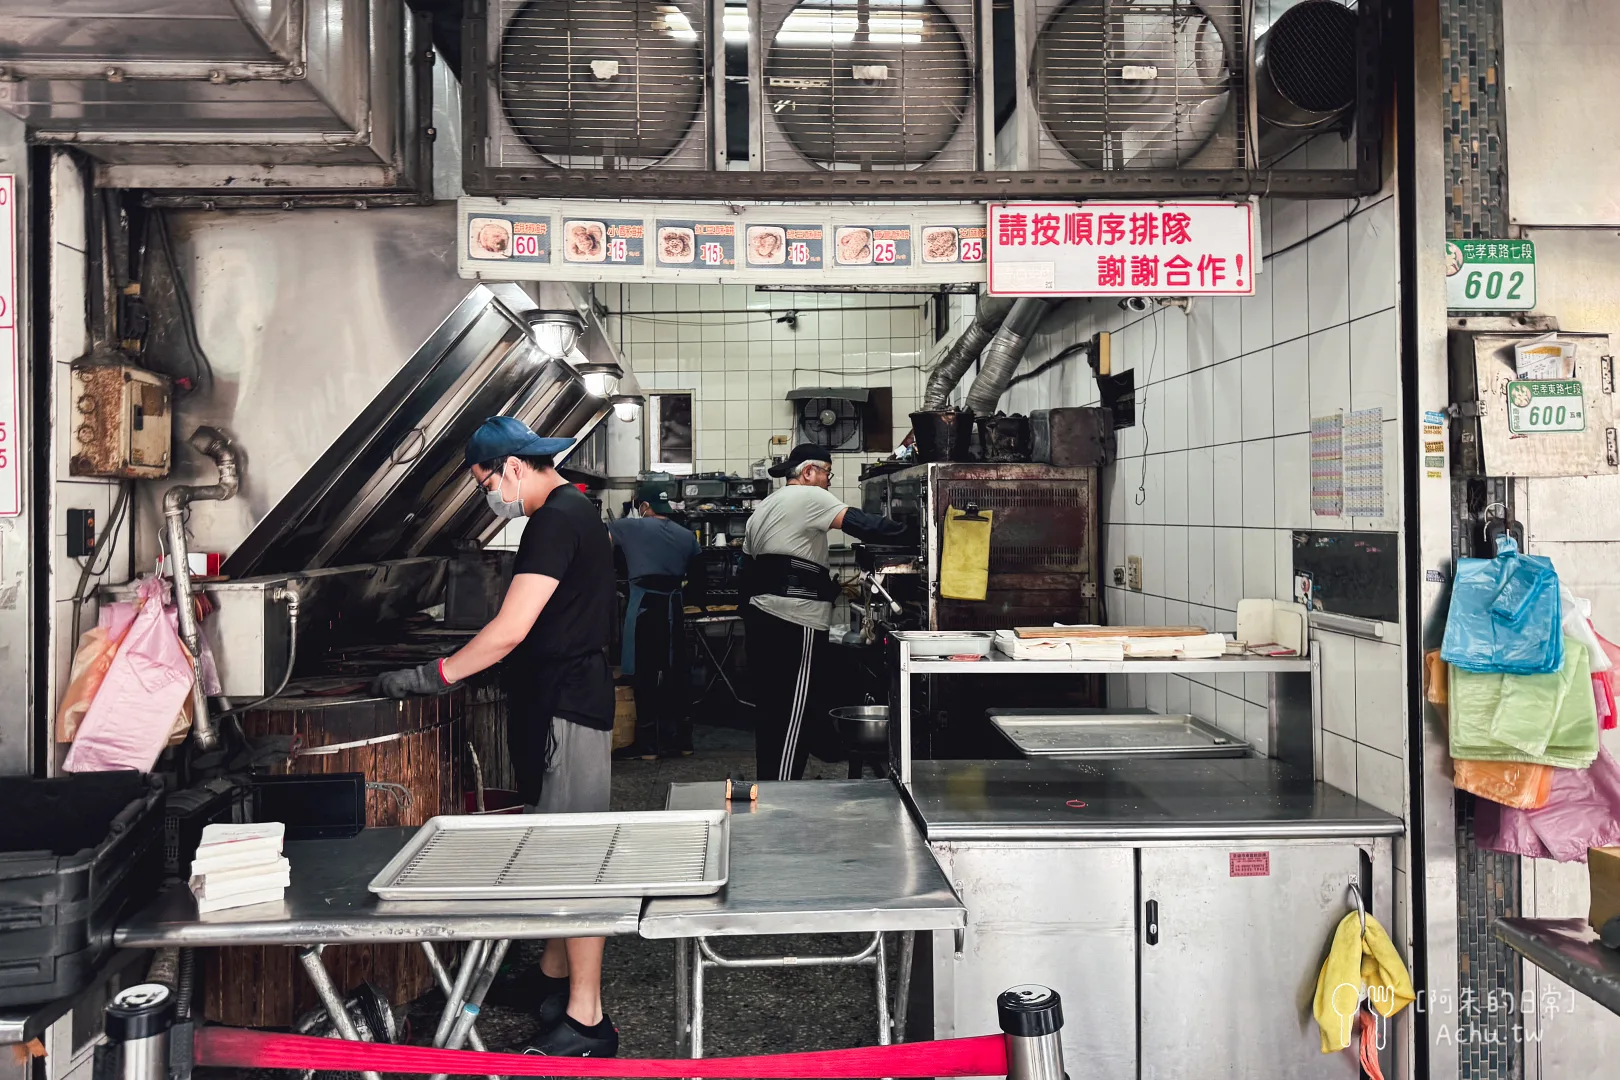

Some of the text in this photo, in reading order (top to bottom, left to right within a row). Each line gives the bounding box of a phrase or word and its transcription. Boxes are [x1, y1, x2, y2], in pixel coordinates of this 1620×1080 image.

[606, 224, 644, 239] 小酥餅
[998, 212, 1192, 246] 請按順序排隊
[515, 237, 537, 255] 60
[612, 241, 624, 260] 15
[707, 244, 718, 262] 15
[794, 245, 805, 262] 15
[875, 244, 894, 262] 25
[962, 242, 981, 260] 25
[1464, 243, 1533, 260] 忠孝東路七段
[1097, 253, 1244, 287] 謝謝合作!
[1465, 271, 1524, 300] 602
[1532, 383, 1581, 395] 忠孝東路七段
[1529, 405, 1567, 426] 600
